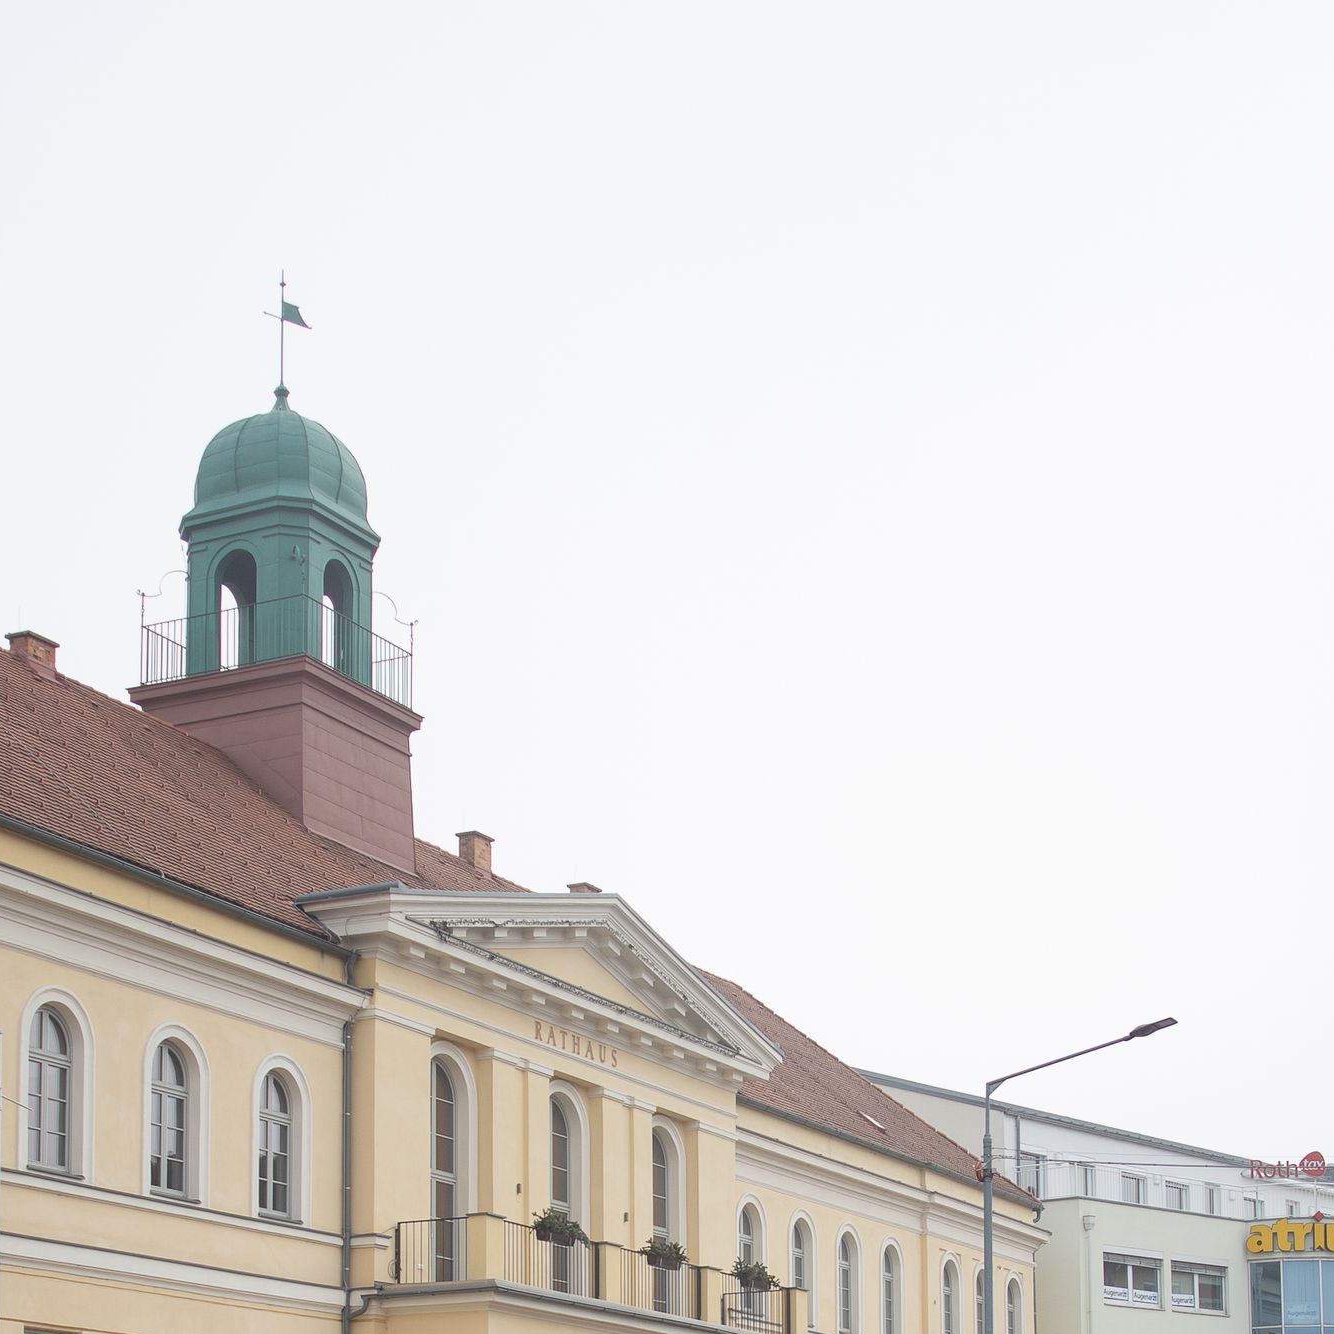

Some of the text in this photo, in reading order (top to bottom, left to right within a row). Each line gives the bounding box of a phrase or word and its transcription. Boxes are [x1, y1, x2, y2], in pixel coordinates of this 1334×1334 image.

[533, 1020, 618, 1068] RATHAUS
[1250, 1160, 1298, 1178] Roth
[1303, 1159, 1324, 1171] tax
